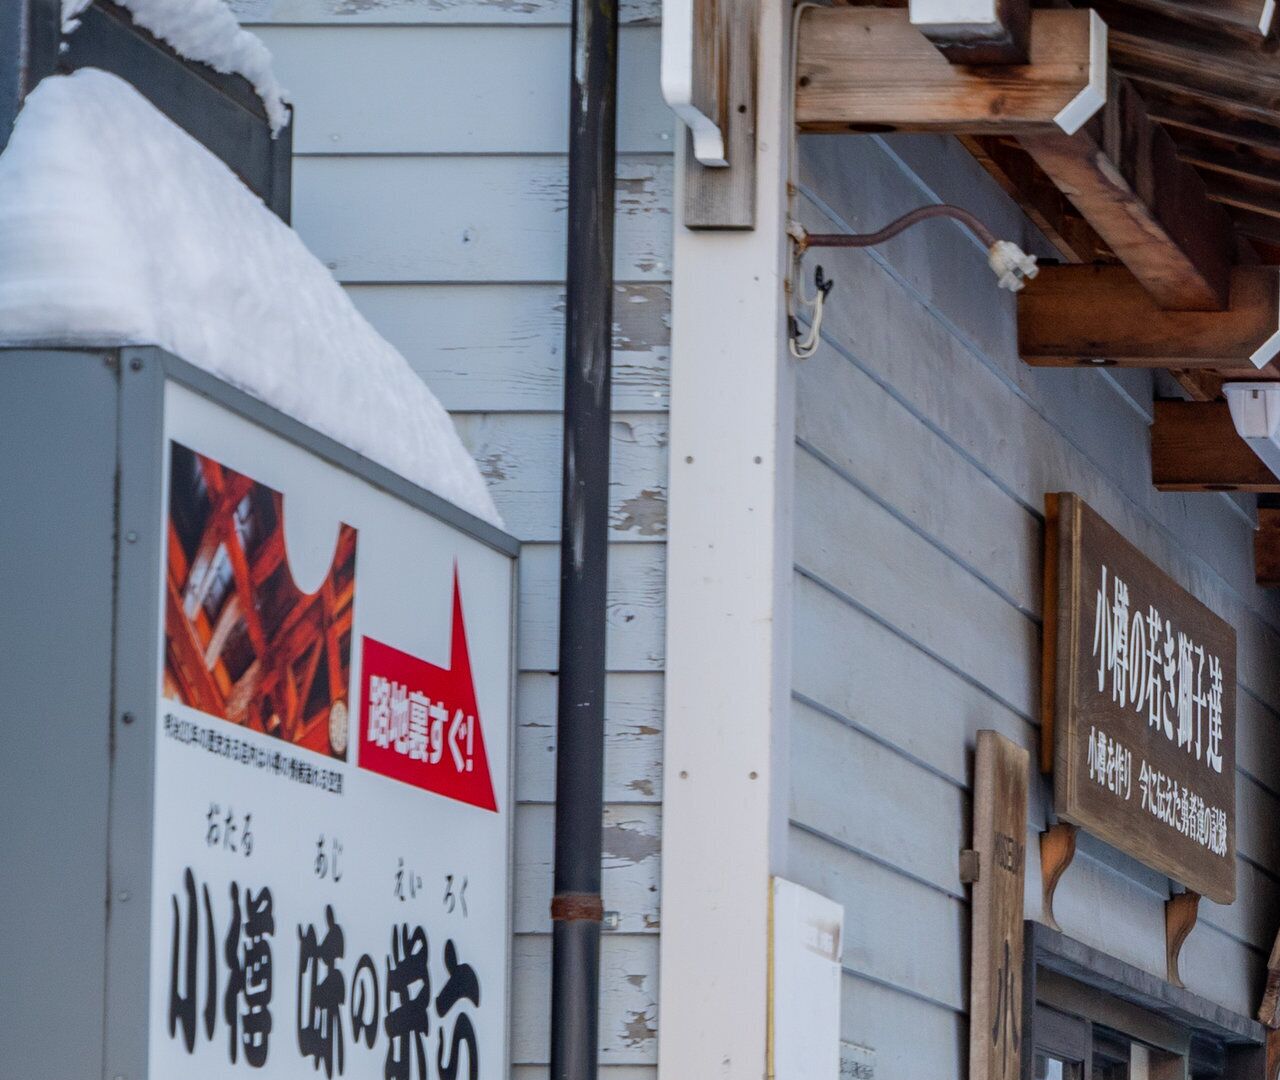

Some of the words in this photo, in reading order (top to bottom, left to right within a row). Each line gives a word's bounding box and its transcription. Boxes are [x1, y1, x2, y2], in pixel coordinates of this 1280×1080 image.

[368, 675, 474, 773] 路地裏すぐ!
[1093, 564, 1223, 774] 小樽の若き獅子達
[1087, 726, 1132, 800] 小樽を作り
[1138, 759, 1228, 857] 今に伝えた勇者達の記録
[205, 803, 254, 856] おたる
[314, 833, 343, 882] あじ
[395, 858, 422, 900] えい
[443, 873, 469, 917] ろく
[168, 866, 274, 1068] 小樽
